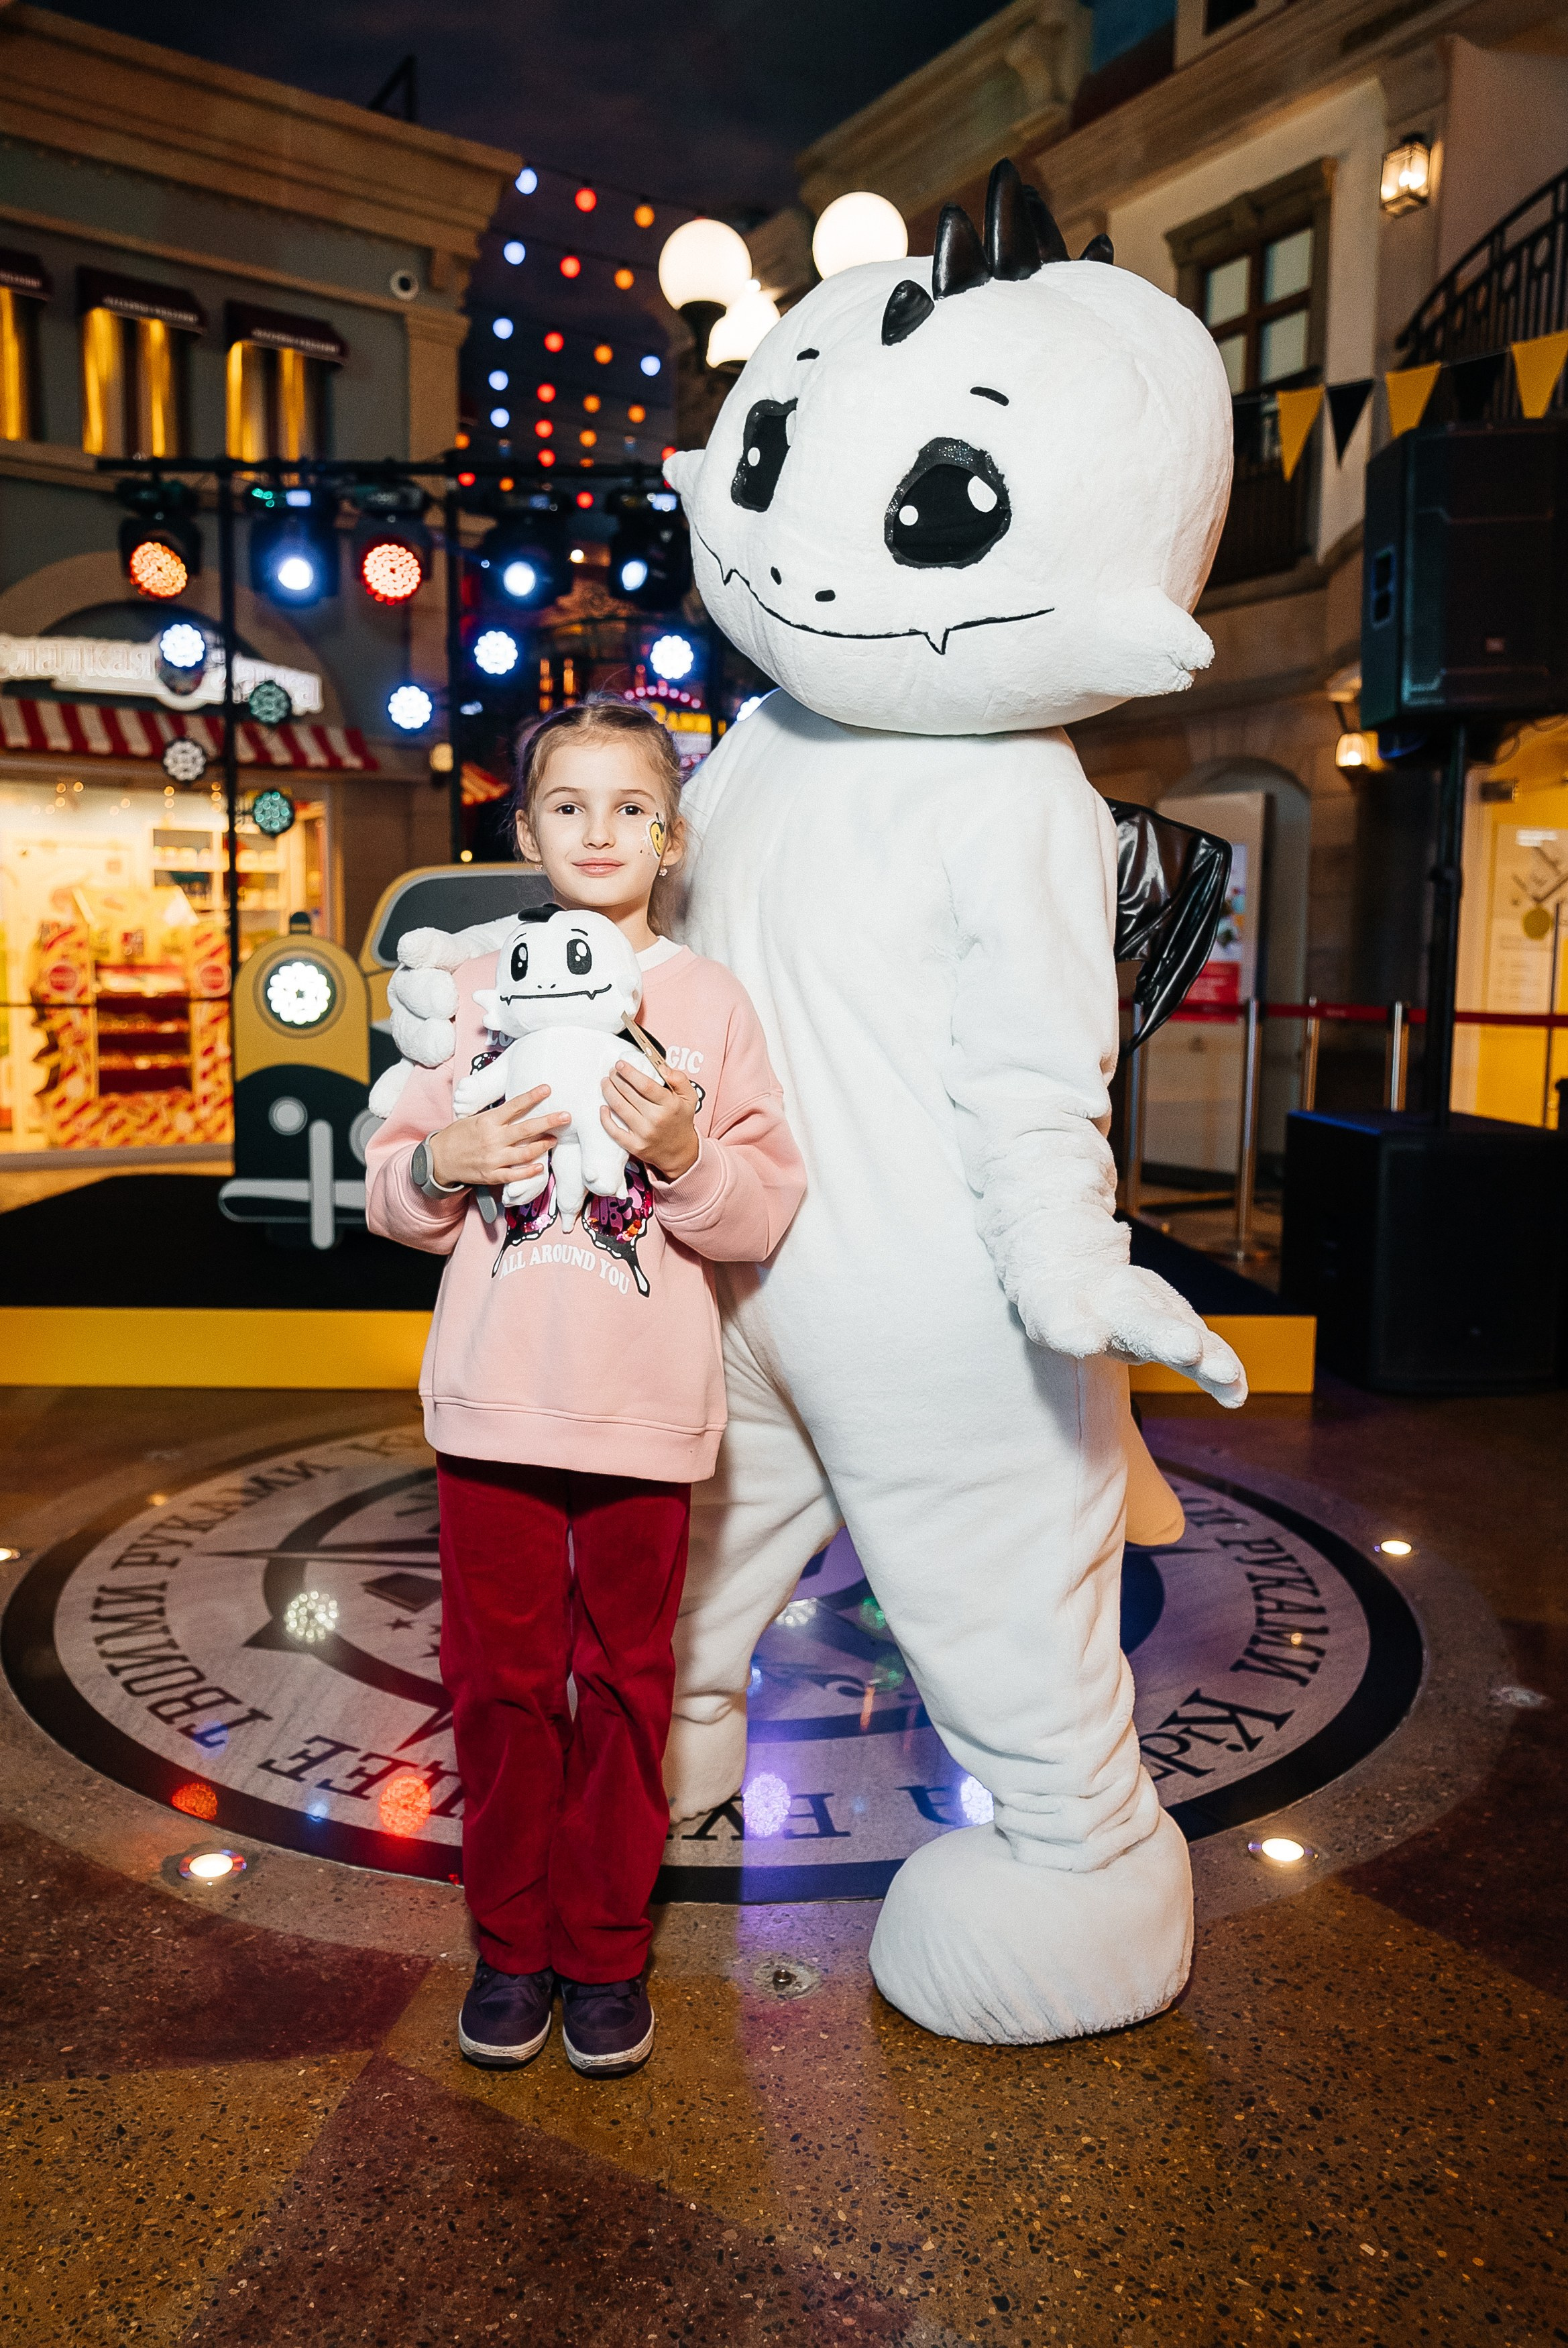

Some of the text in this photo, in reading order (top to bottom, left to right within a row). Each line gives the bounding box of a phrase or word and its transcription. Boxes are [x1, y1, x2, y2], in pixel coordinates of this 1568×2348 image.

[665, 1045, 704, 1075] GIC
[499, 1244, 630, 1294] ALL AROUND YOU
[110, 1460, 340, 1570] РУКАМИ
[89, 1581, 273, 1749] ТВОИМИ
[1215, 1536, 1329, 1688] РУКАМИ
